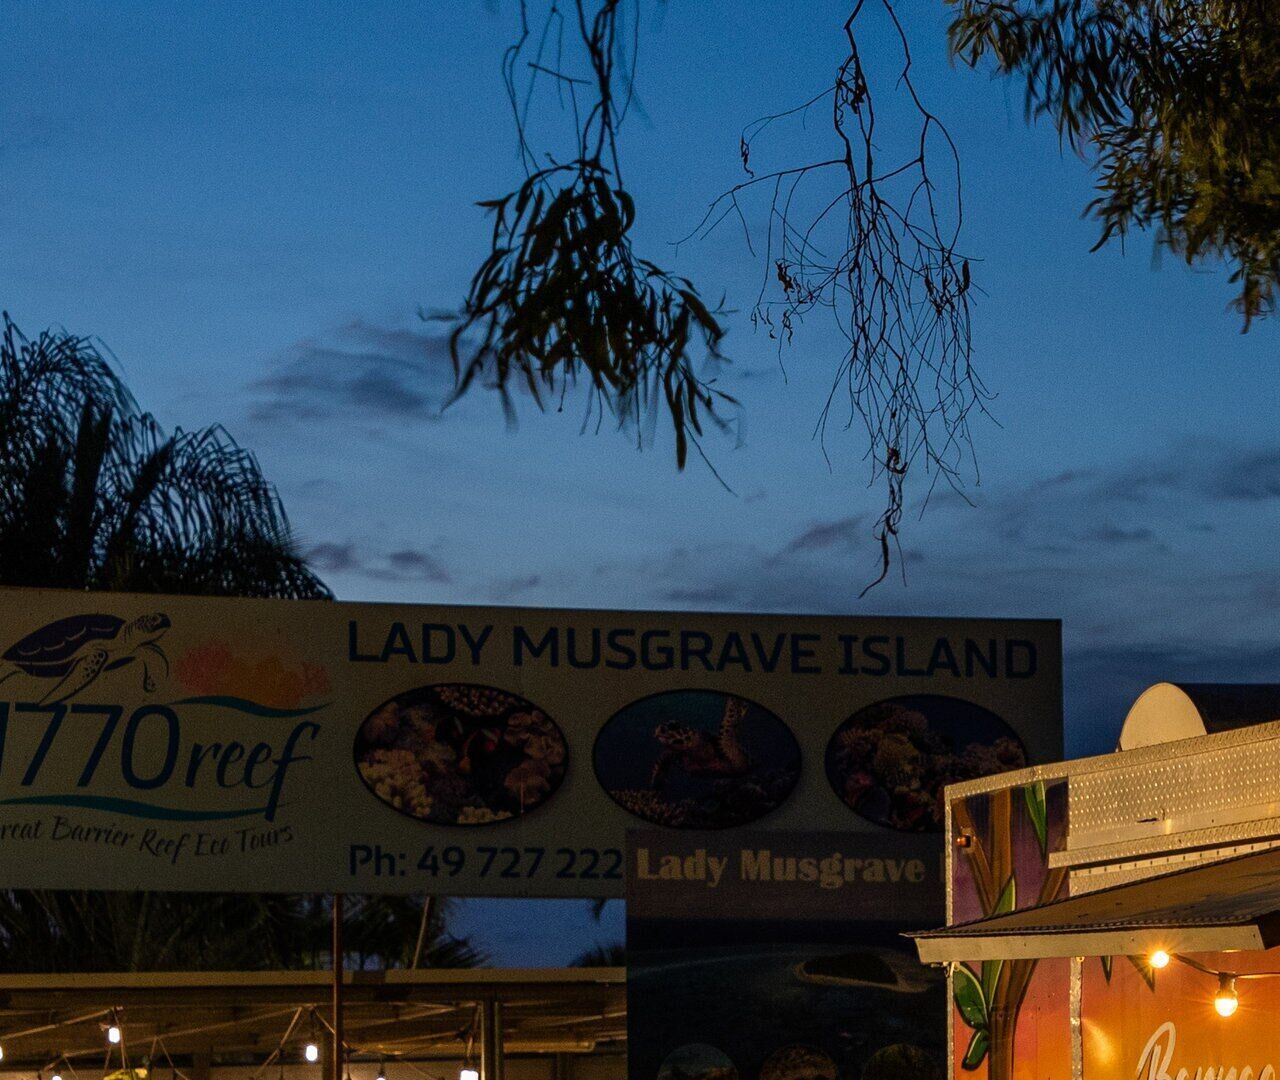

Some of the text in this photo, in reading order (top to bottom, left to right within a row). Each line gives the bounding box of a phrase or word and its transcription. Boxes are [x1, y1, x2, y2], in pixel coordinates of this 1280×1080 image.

[348, 620, 1039, 680] LADY MUSGRAVE ISLAND
[186, 721, 321, 822] reef
[52, 815, 133, 848] Barrier
[139, 825, 193, 863] Reef
[194, 829, 229, 855] Eco
[240, 823, 293, 854] Tours
[349, 844, 623, 881] Ph: 49 727 222
[635, 846, 729, 888] Lady
[739, 846, 927, 891] Musgrave
